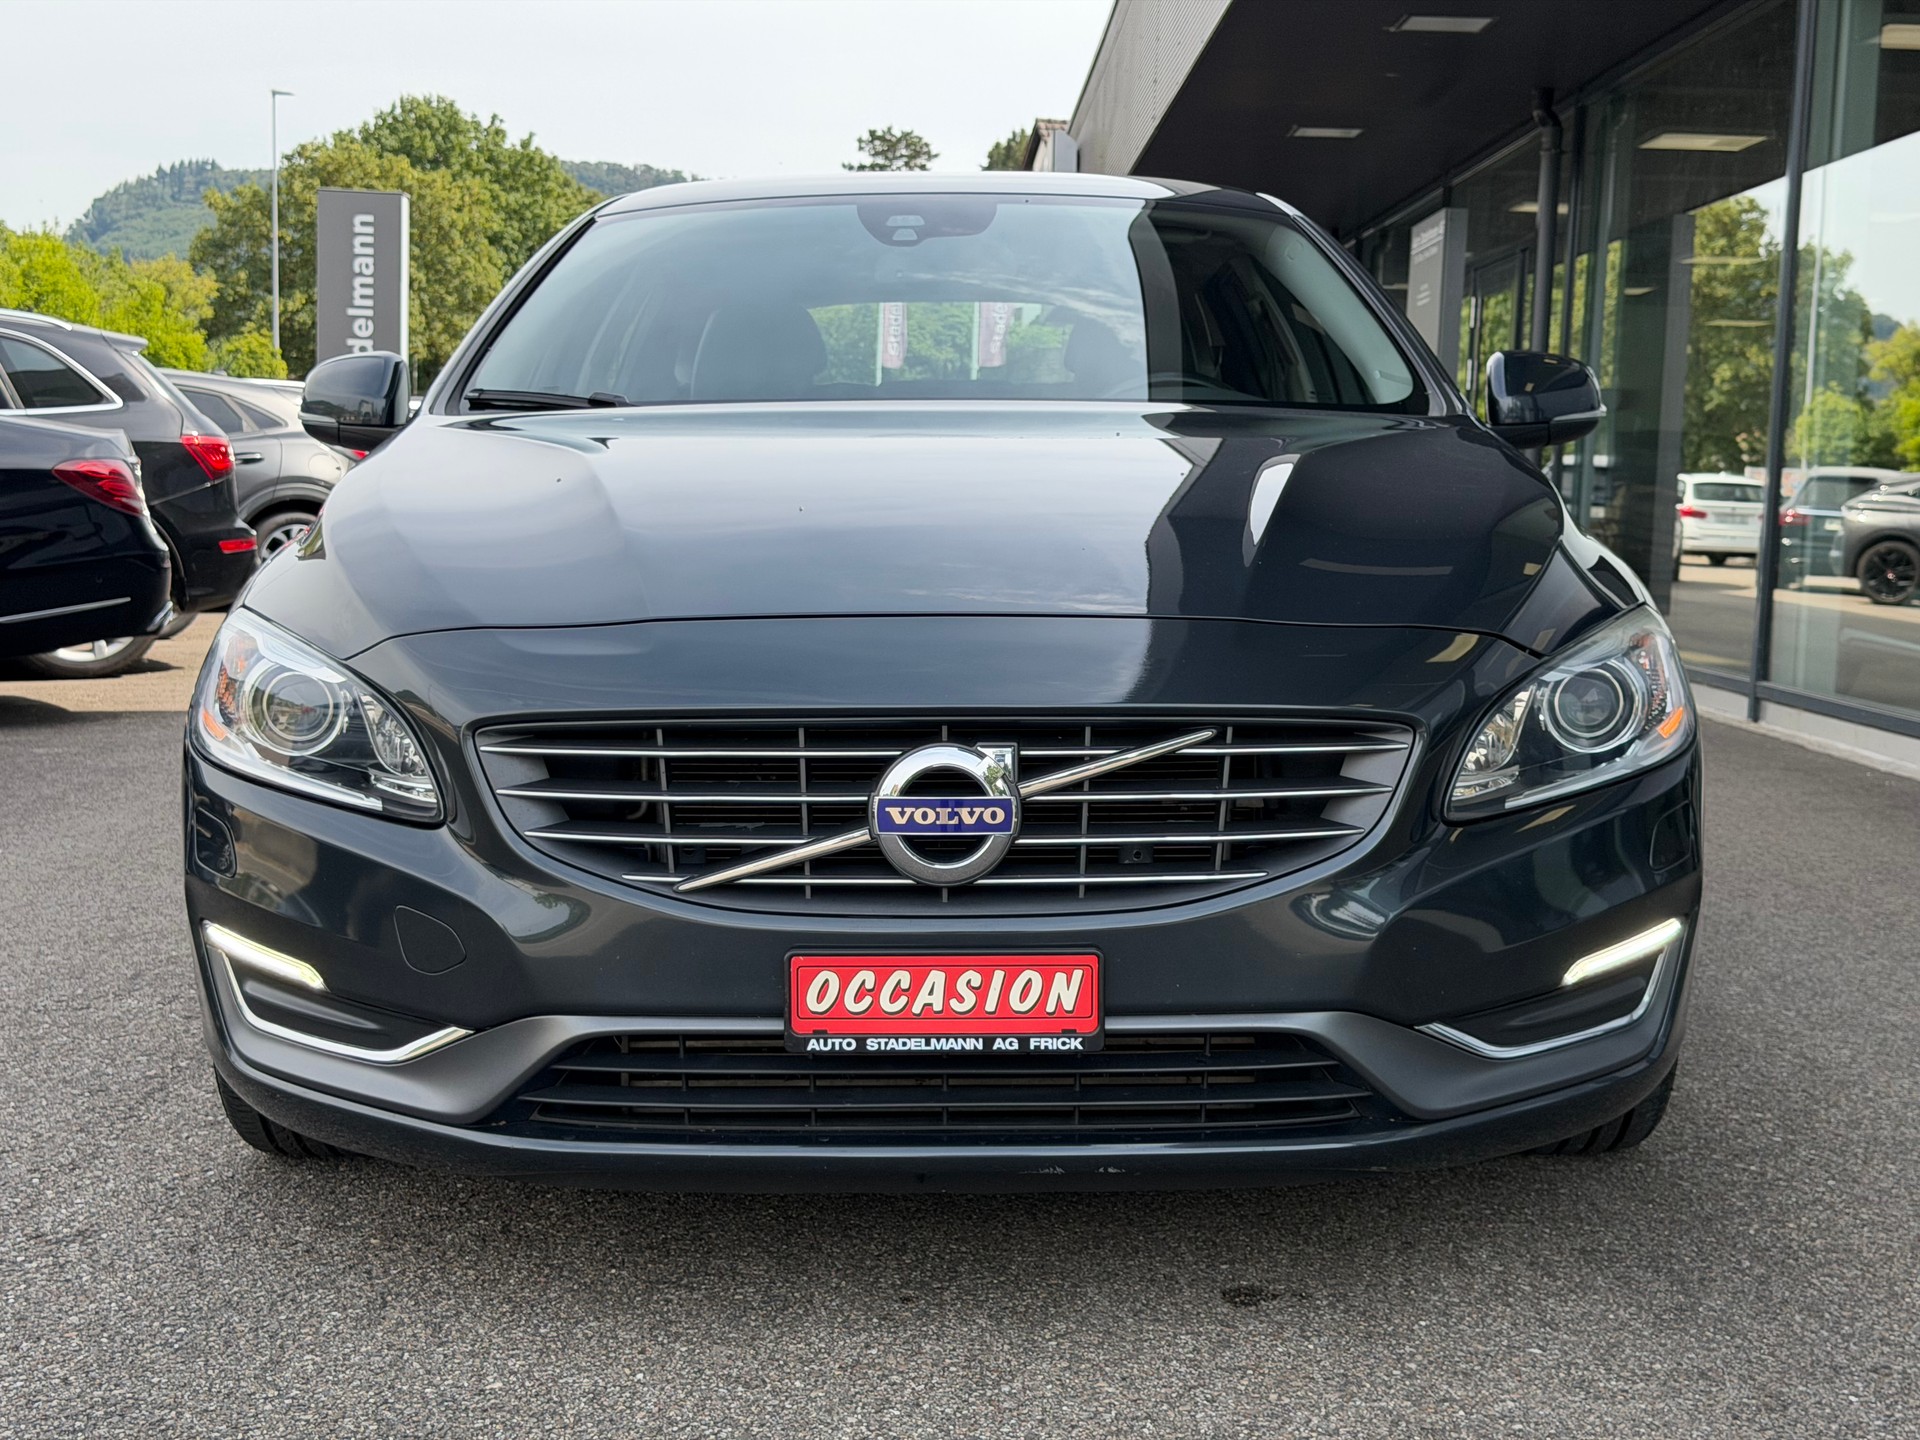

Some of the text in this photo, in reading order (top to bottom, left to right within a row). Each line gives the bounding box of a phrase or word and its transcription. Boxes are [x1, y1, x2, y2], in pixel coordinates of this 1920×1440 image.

[885, 807, 1005, 824] VOLVO
[806, 970, 1084, 1015] OCCASION
[807, 1038, 1083, 1051] AUTO STADELMANN AG FRICK
